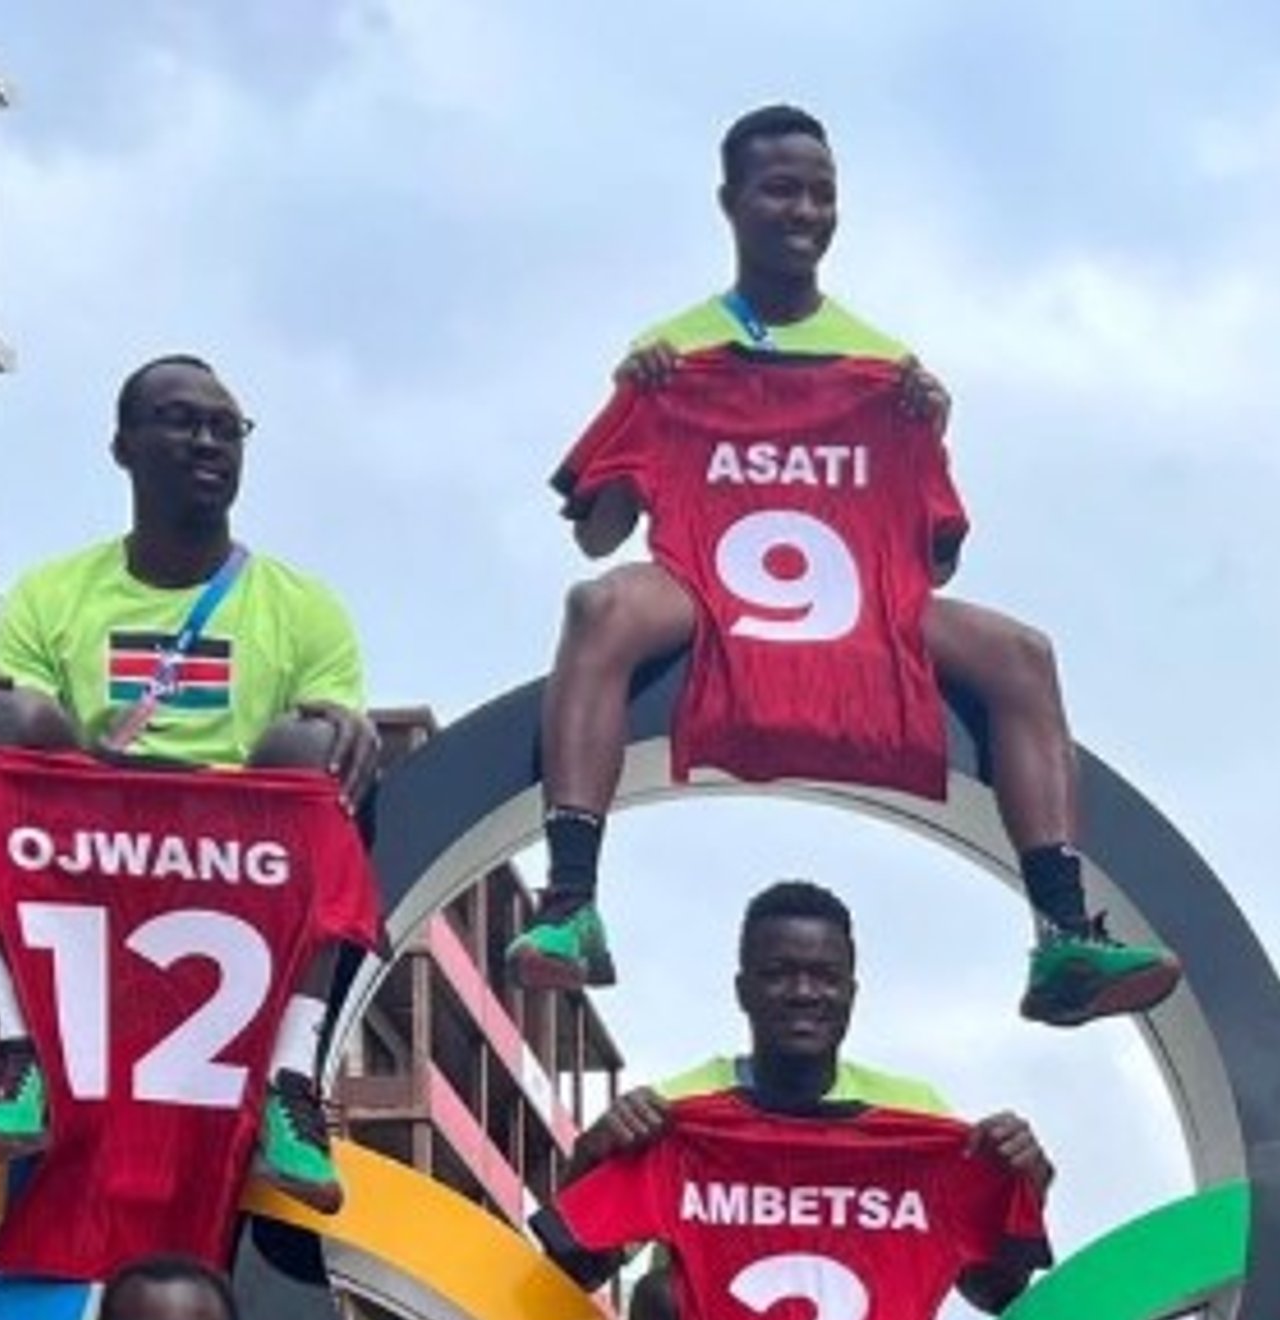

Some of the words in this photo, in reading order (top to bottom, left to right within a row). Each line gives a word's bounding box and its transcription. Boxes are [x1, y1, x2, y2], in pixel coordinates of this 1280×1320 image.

[706, 441, 868, 487] ASATI
[715, 509, 863, 643] 9
[7, 826, 290, 885] OJWANG
[16, 902, 273, 1109] 12
[680, 1181, 929, 1231] AMBETSA
